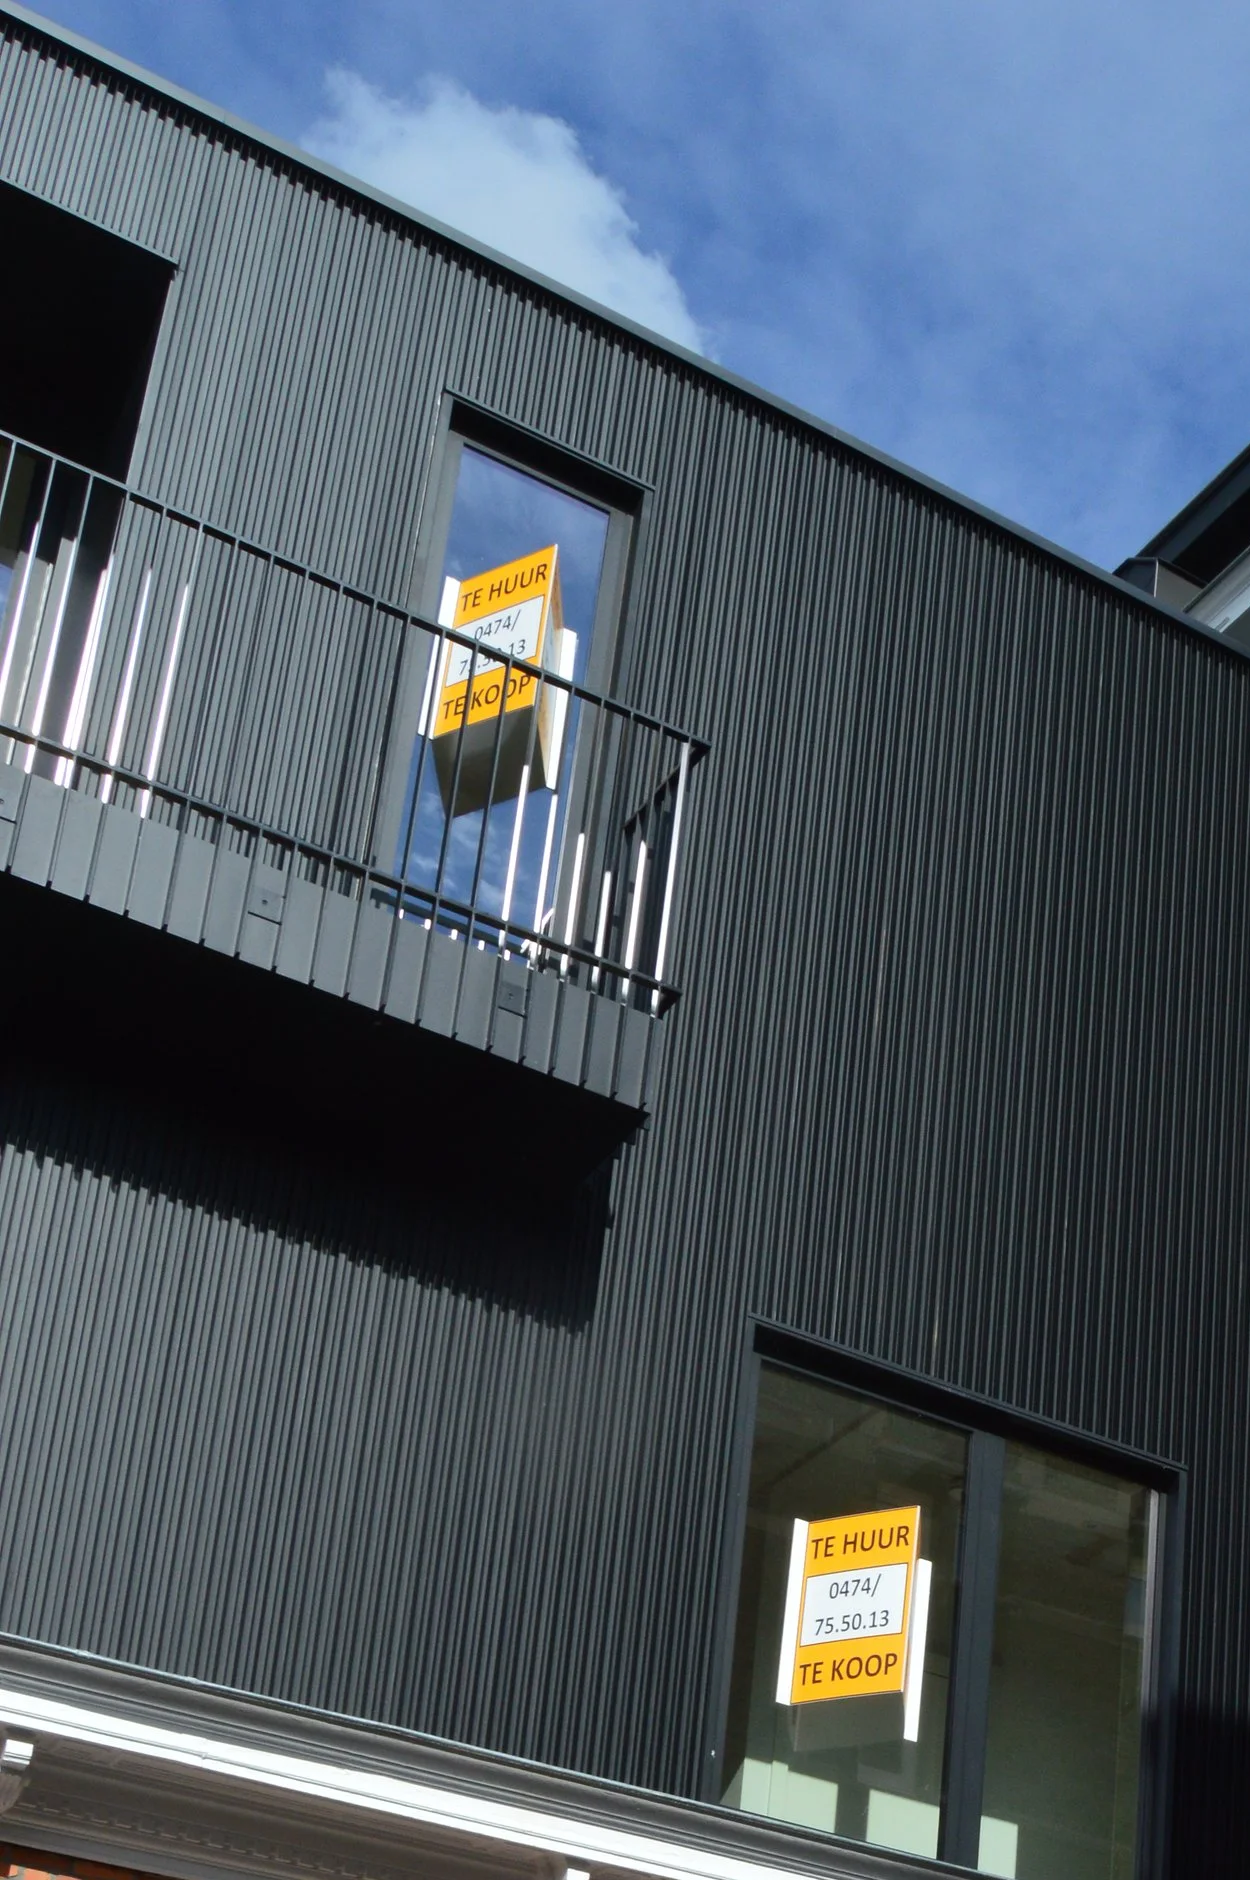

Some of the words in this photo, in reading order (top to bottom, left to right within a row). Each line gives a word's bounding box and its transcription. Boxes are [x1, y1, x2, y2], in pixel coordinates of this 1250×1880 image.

[461, 588, 483, 612] TE
[488, 563, 548, 602] HUUR
[474, 608, 522, 641] 0474/
[443, 695, 468, 720] TE
[470, 674, 532, 711] KOOP
[811, 1535, 836, 1560] TE
[842, 1525, 910, 1555] HUUR
[829, 1573, 882, 1600] 0474/
[814, 1609, 890, 1637] 75.50.13
[799, 1661, 824, 1686] TE
[830, 1652, 898, 1682] KOOP
